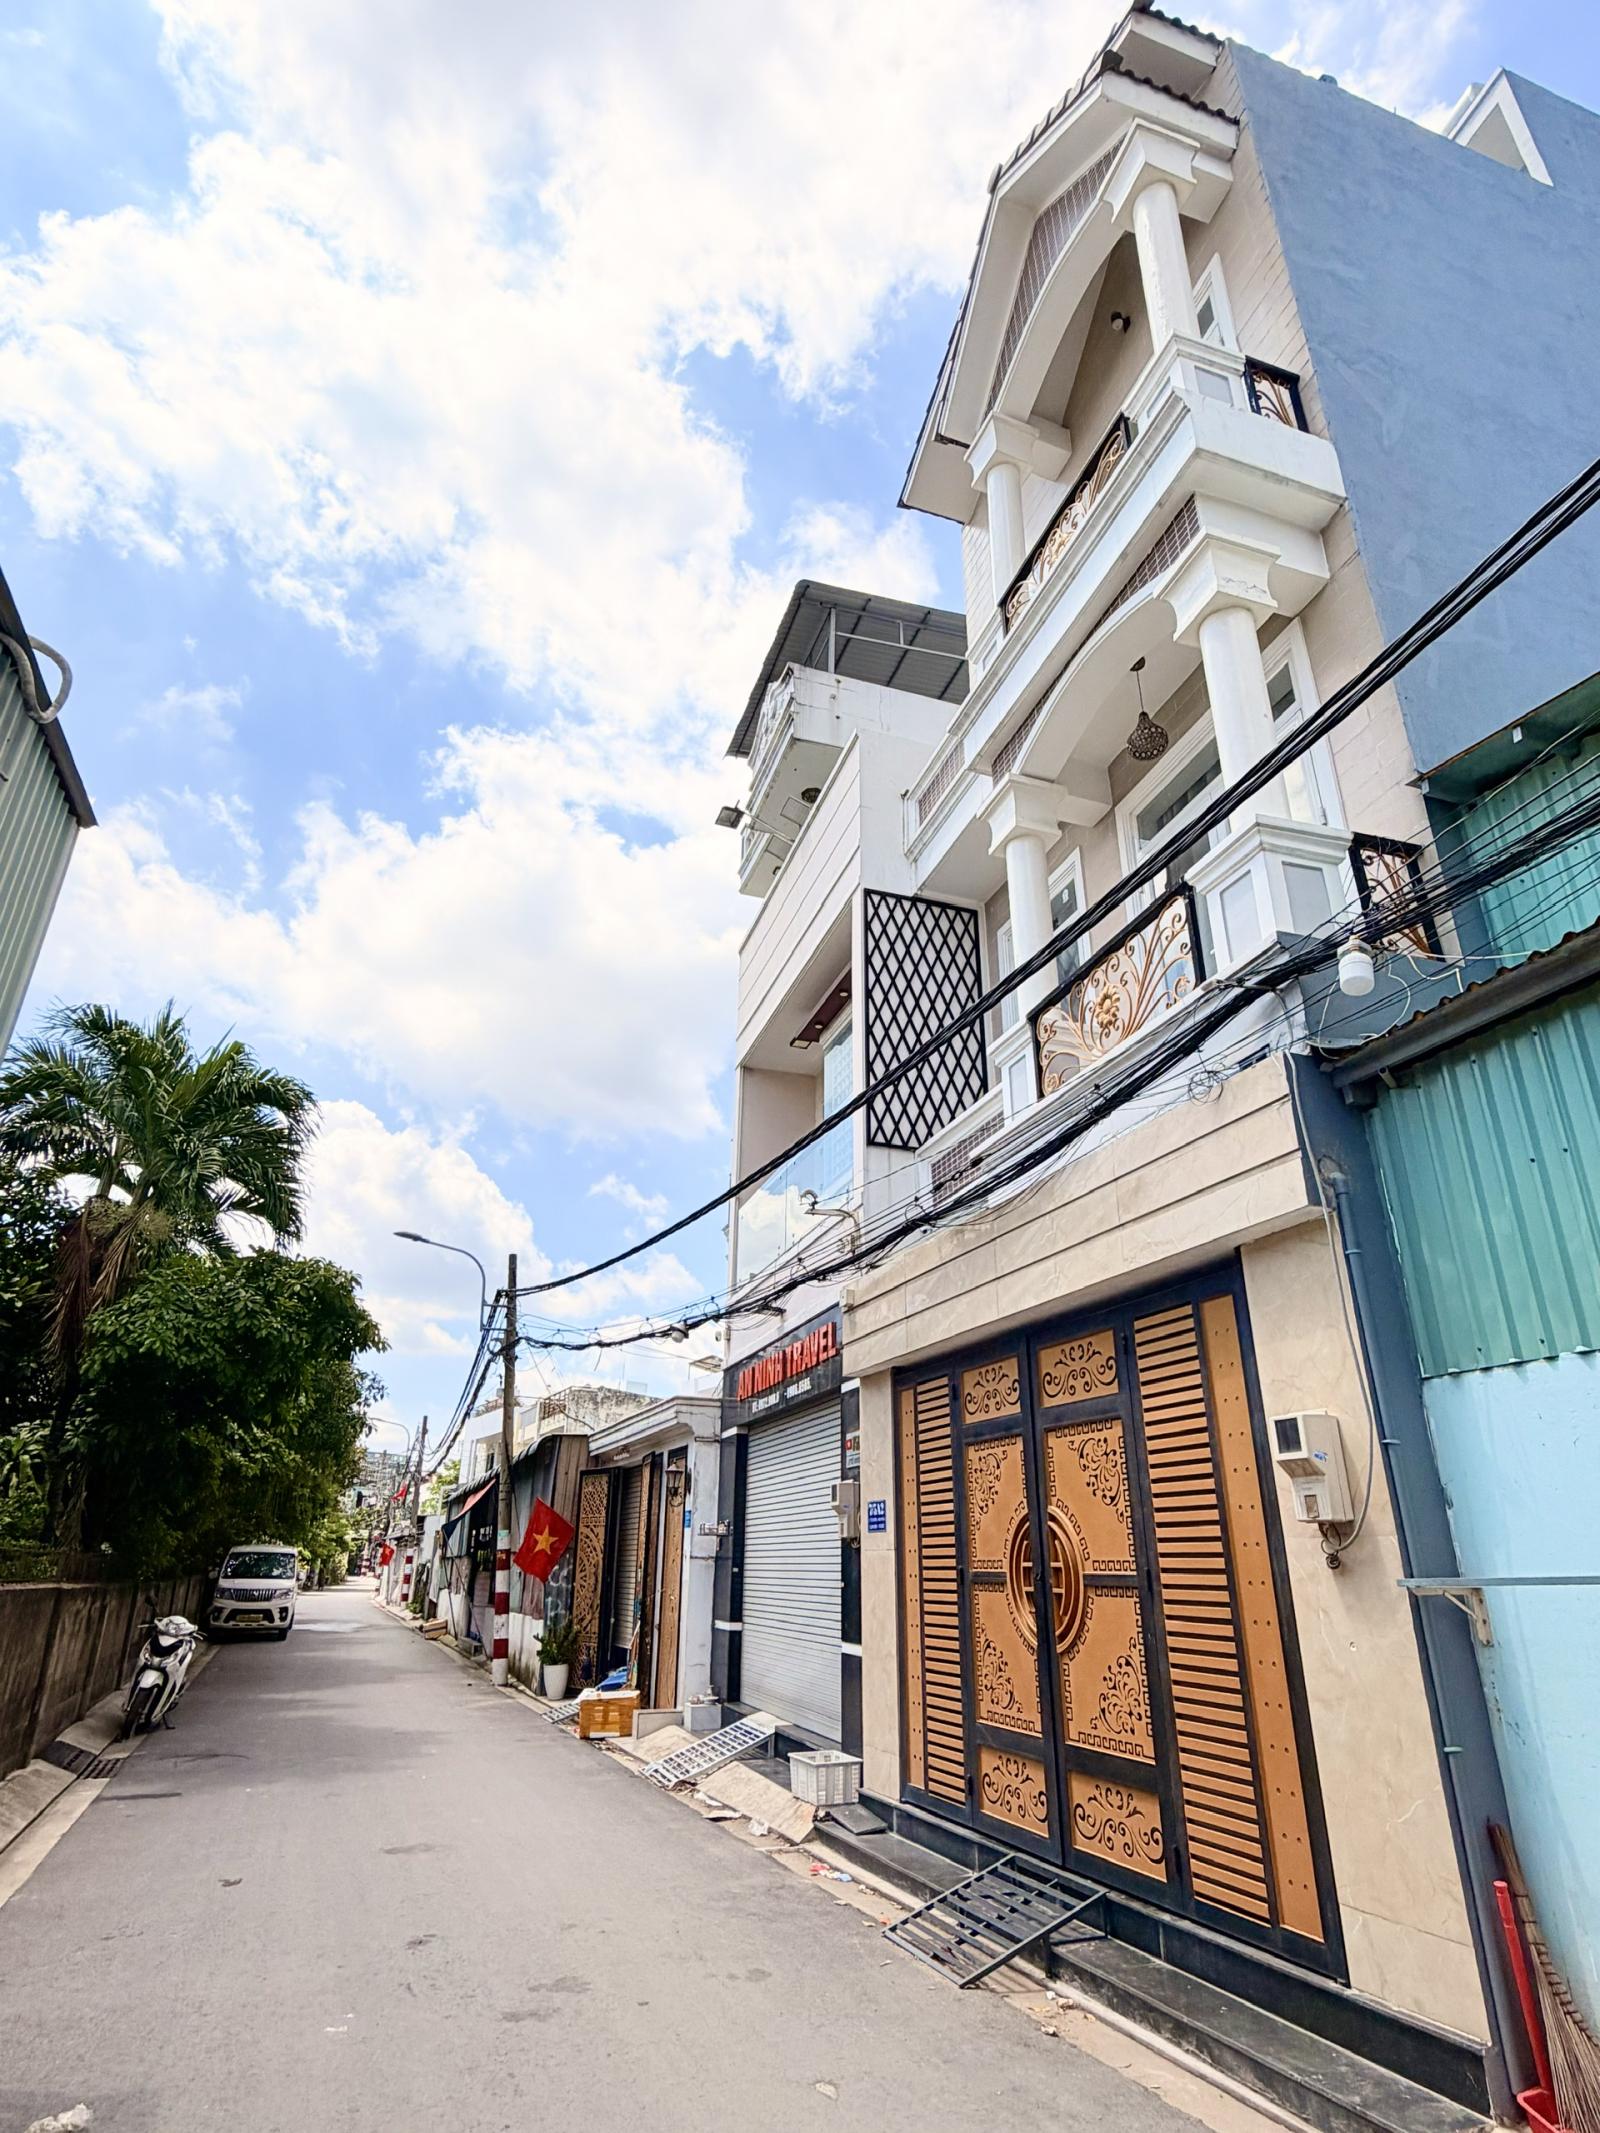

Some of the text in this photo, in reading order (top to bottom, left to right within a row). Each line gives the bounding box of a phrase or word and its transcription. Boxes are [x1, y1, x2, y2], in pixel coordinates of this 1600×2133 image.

[736, 1366, 754, 1402] AN
[754, 1349, 783, 1393] NINH
[786, 1322, 838, 1378] TRAVEL
